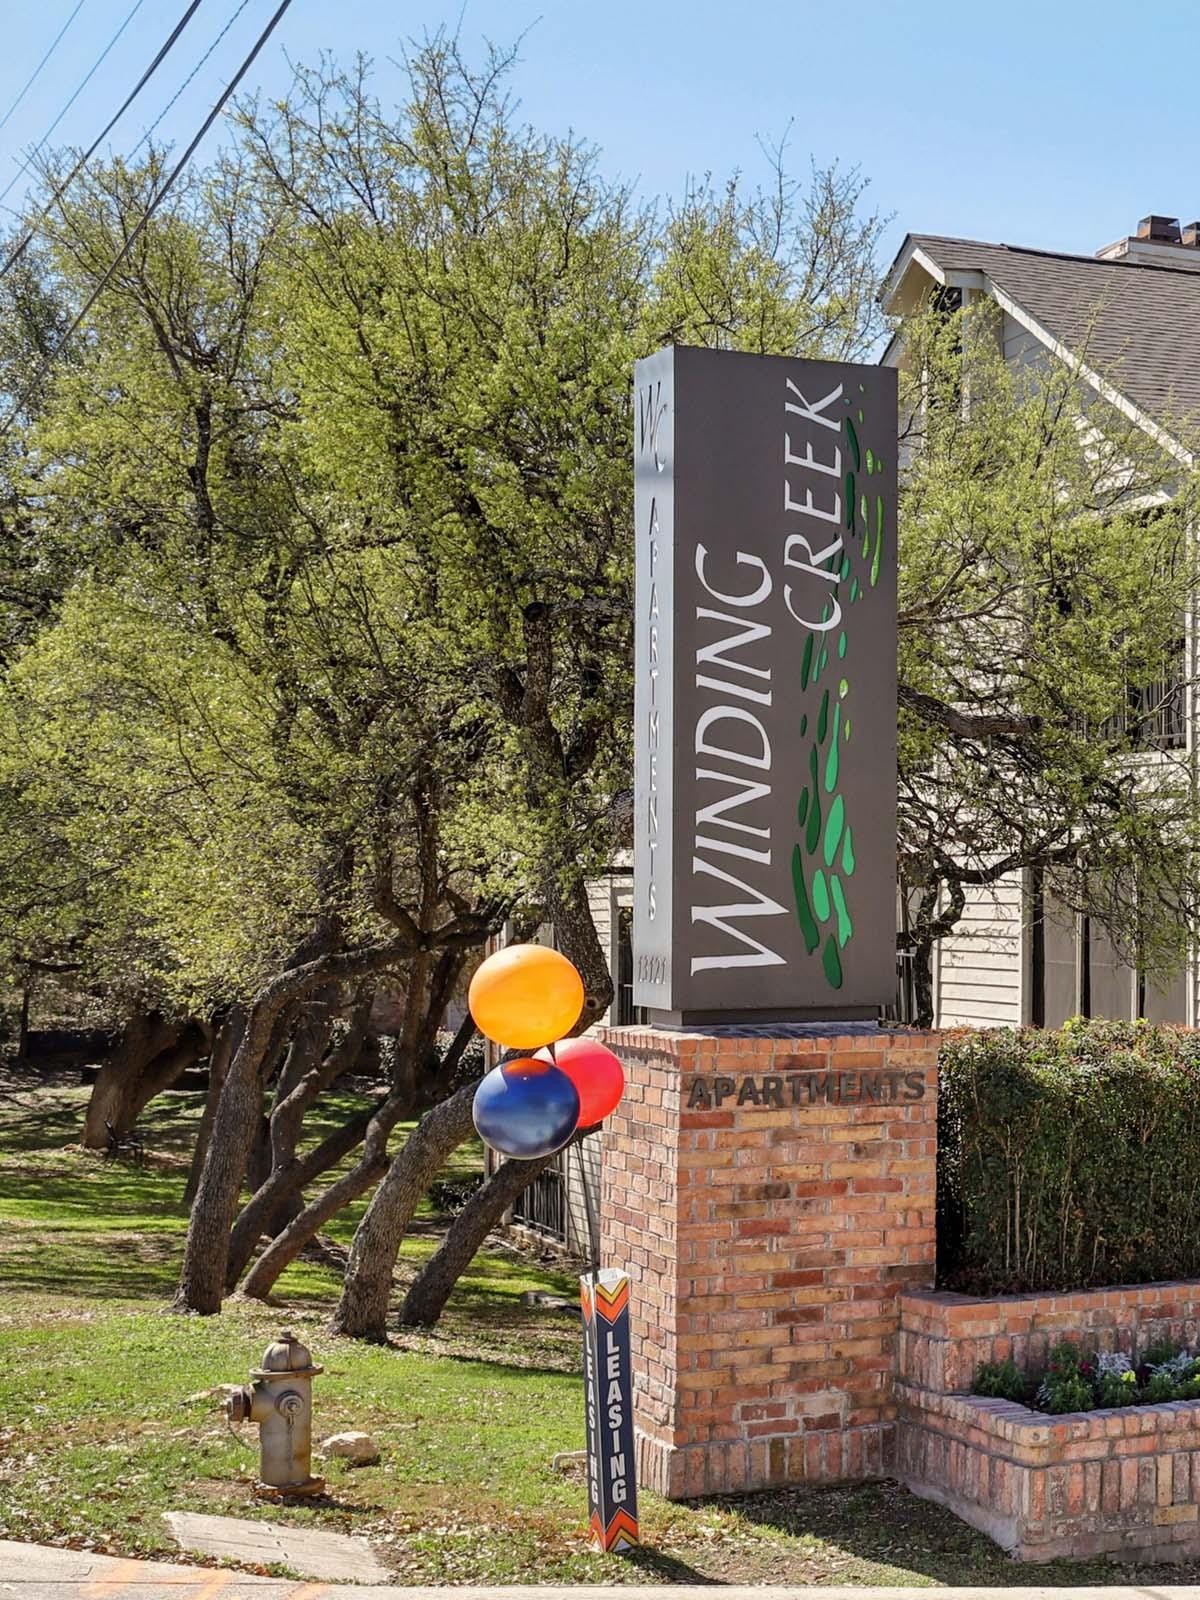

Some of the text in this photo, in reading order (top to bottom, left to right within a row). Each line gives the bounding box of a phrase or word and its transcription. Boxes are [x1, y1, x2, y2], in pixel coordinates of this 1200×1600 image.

[784, 377, 843, 631] CREEK
[648, 497, 660, 921] APARTMENTS
[691, 543, 789, 976] WINDING
[686, 1070, 925, 1109] APARTMENTS
[585, 1331, 599, 1504] LEASING
[606, 1331, 627, 1504] LEASING
